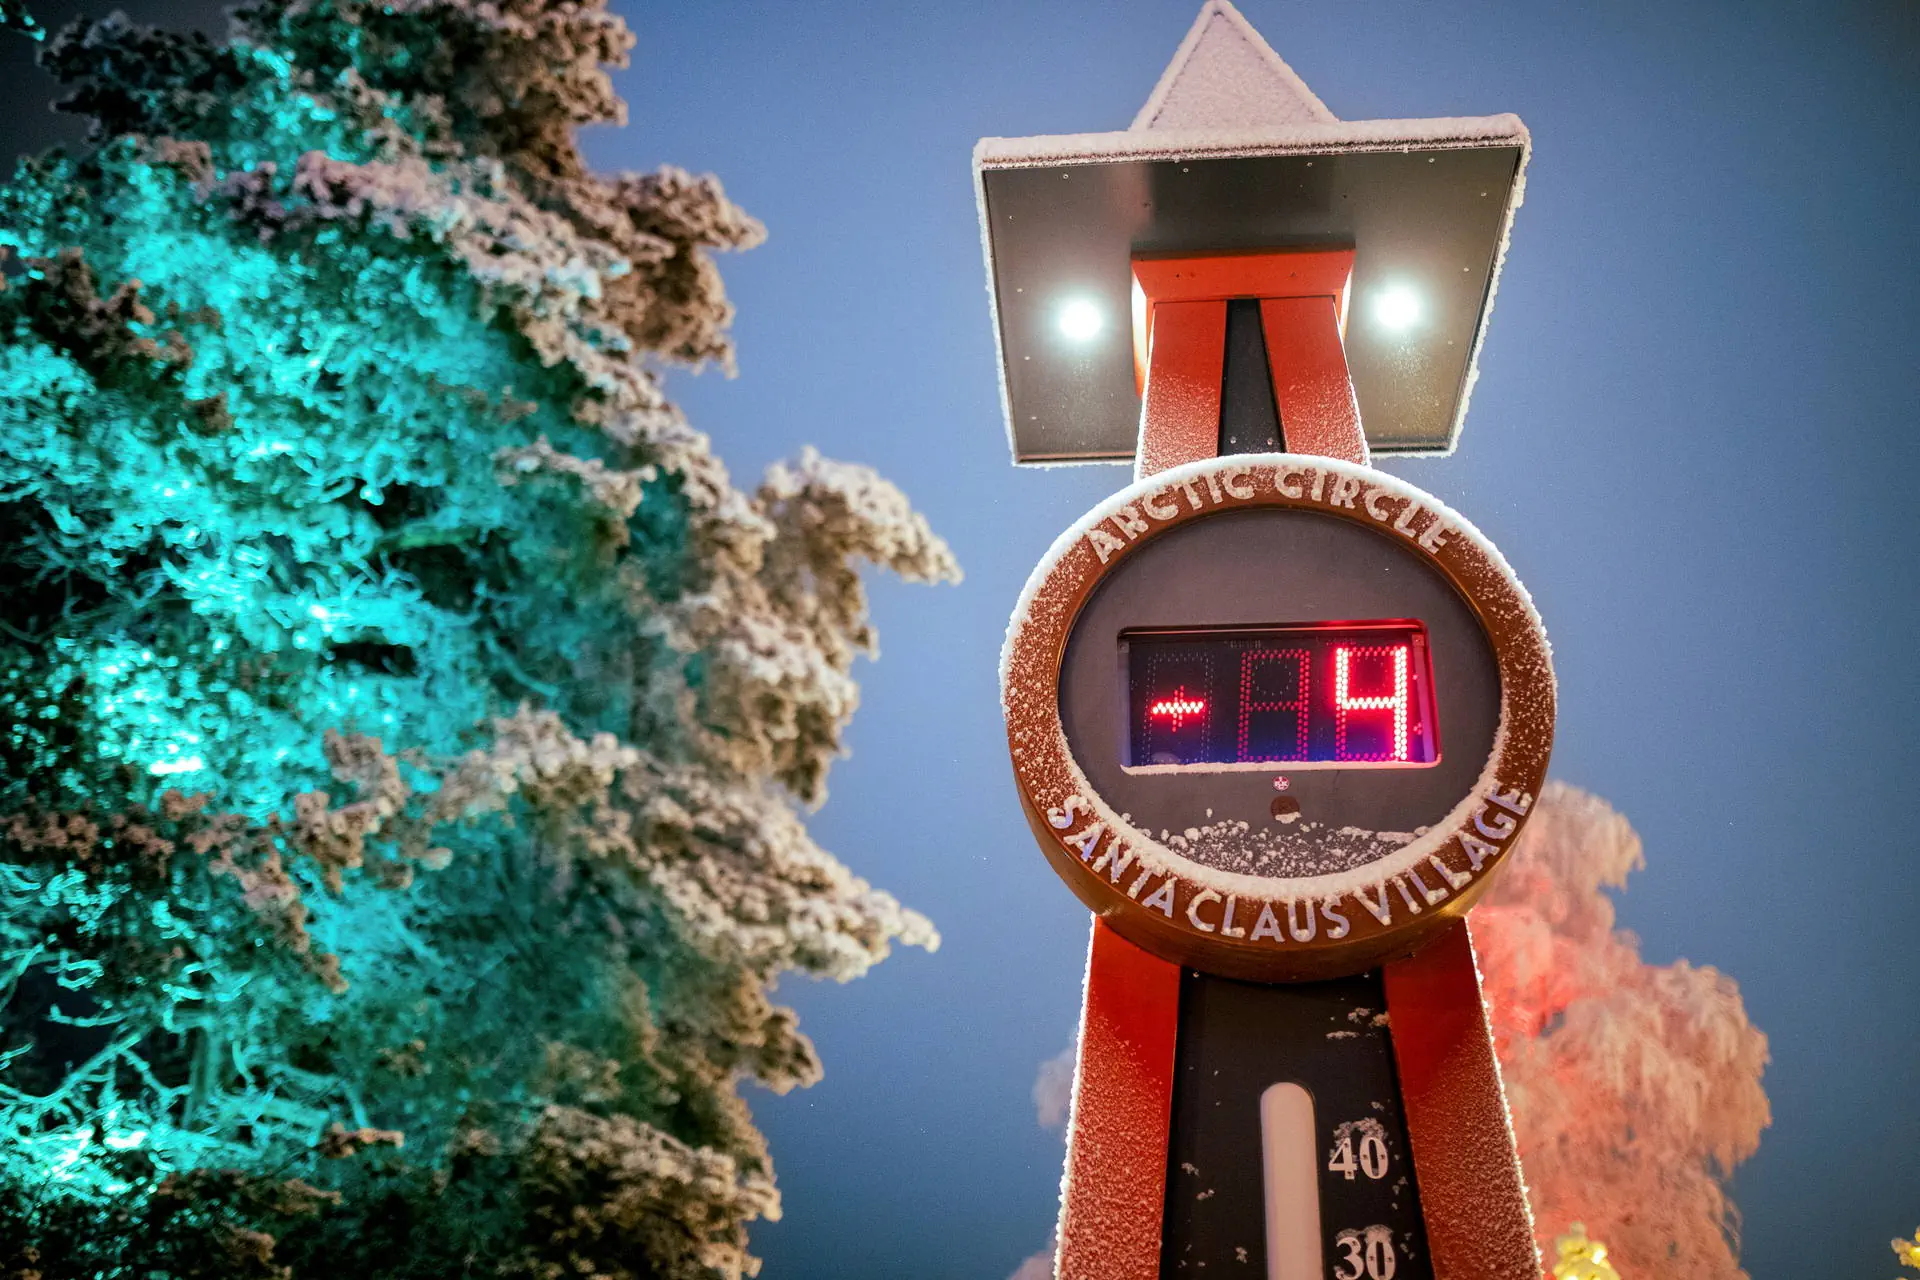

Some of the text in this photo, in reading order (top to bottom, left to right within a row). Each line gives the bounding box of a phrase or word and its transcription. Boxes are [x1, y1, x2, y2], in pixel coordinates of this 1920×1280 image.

[1088, 466, 1455, 564] ARCTIC CIRCLE
[1336, 646, 1408, 761] 4
[1047, 782, 1533, 942] SANTA CLAUS VILLAGE
[1328, 1134, 1389, 1180] 40
[1334, 1233, 1396, 1280] 30
